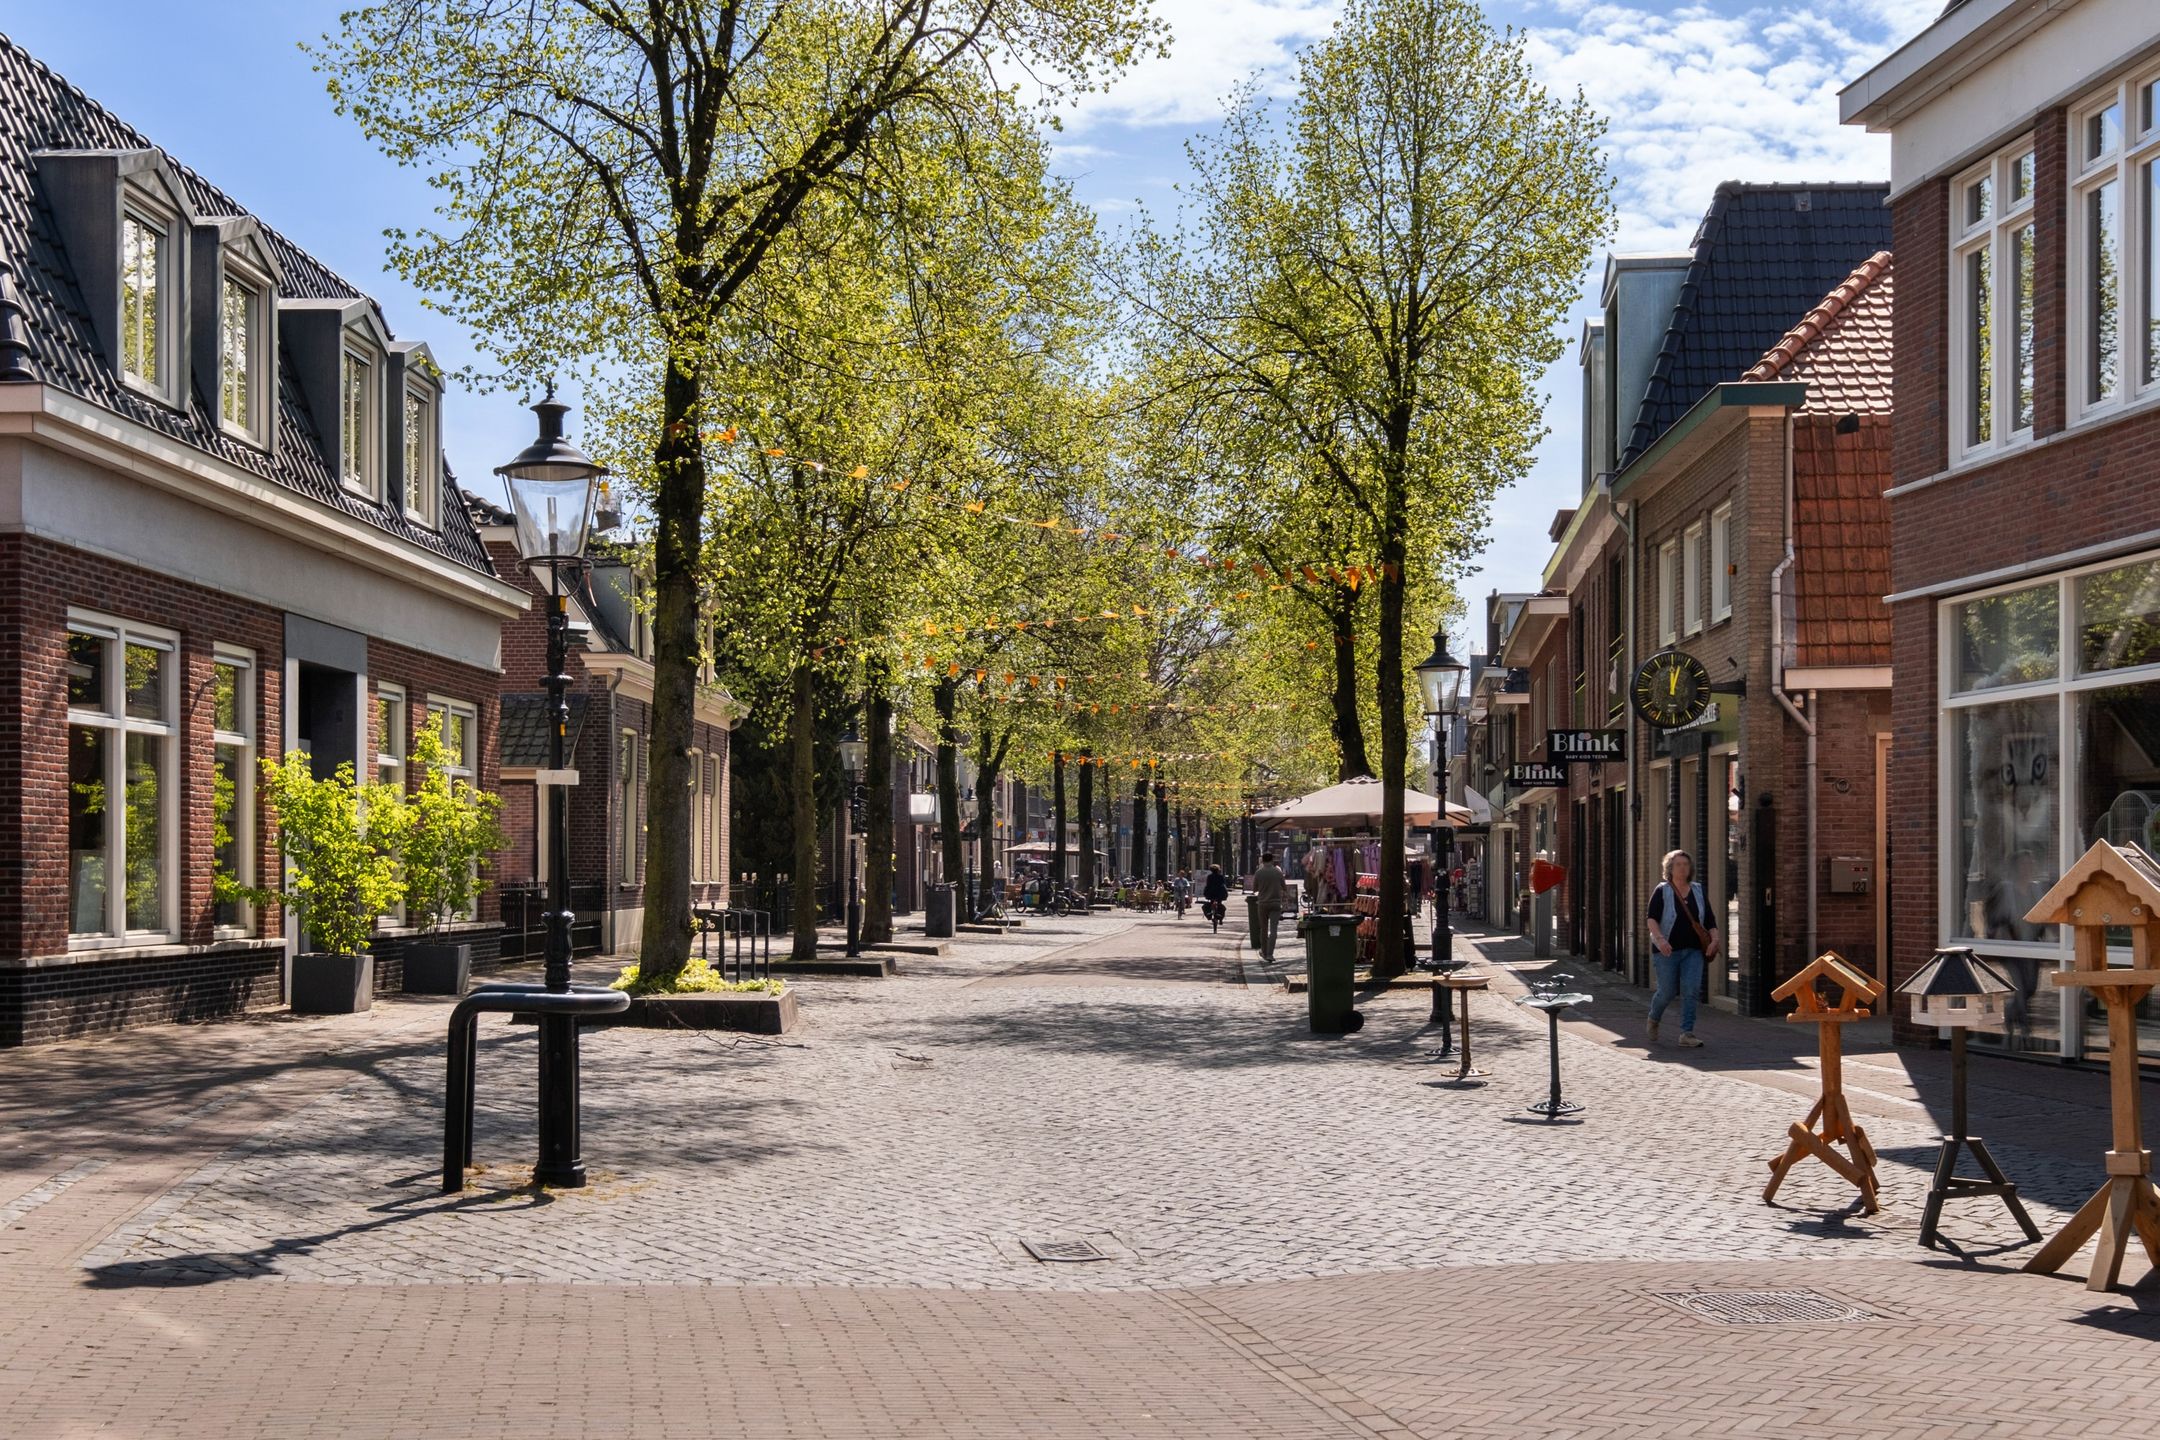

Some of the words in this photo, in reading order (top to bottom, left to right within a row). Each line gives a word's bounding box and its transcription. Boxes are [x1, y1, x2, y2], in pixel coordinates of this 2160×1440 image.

[1552, 732, 1620, 751] Blink
[1513, 764, 1564, 779] Blink
[1852, 881, 1867, 894] 123
